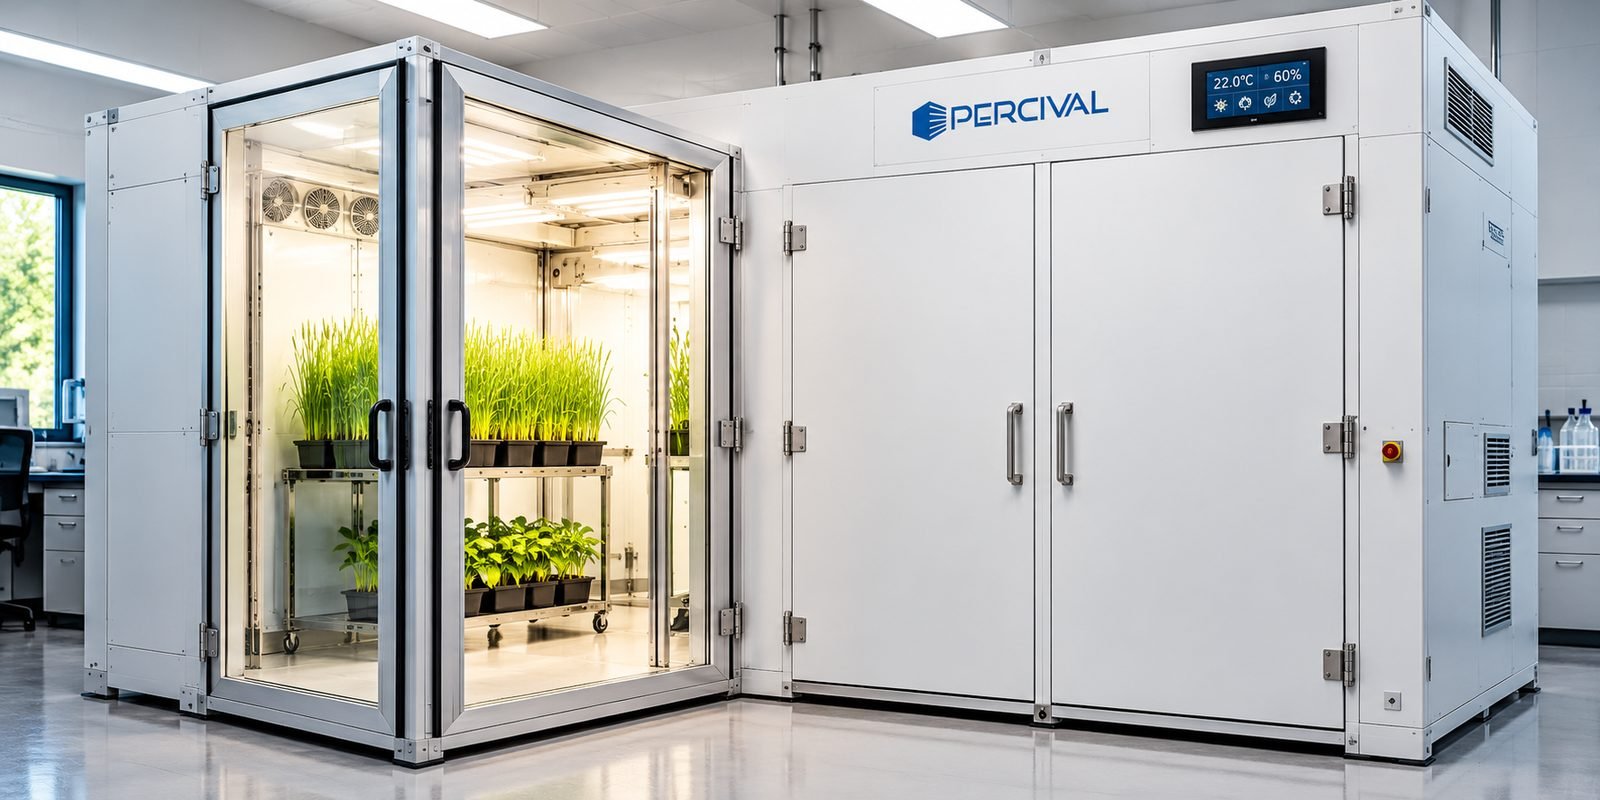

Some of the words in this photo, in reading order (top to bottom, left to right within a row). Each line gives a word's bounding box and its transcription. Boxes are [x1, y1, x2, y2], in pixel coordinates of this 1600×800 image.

[1214, 74, 1253, 89] 22.0°C
[1273, 68, 1302, 83] 60%
[951, 90, 1109, 130] PERCIVAL
